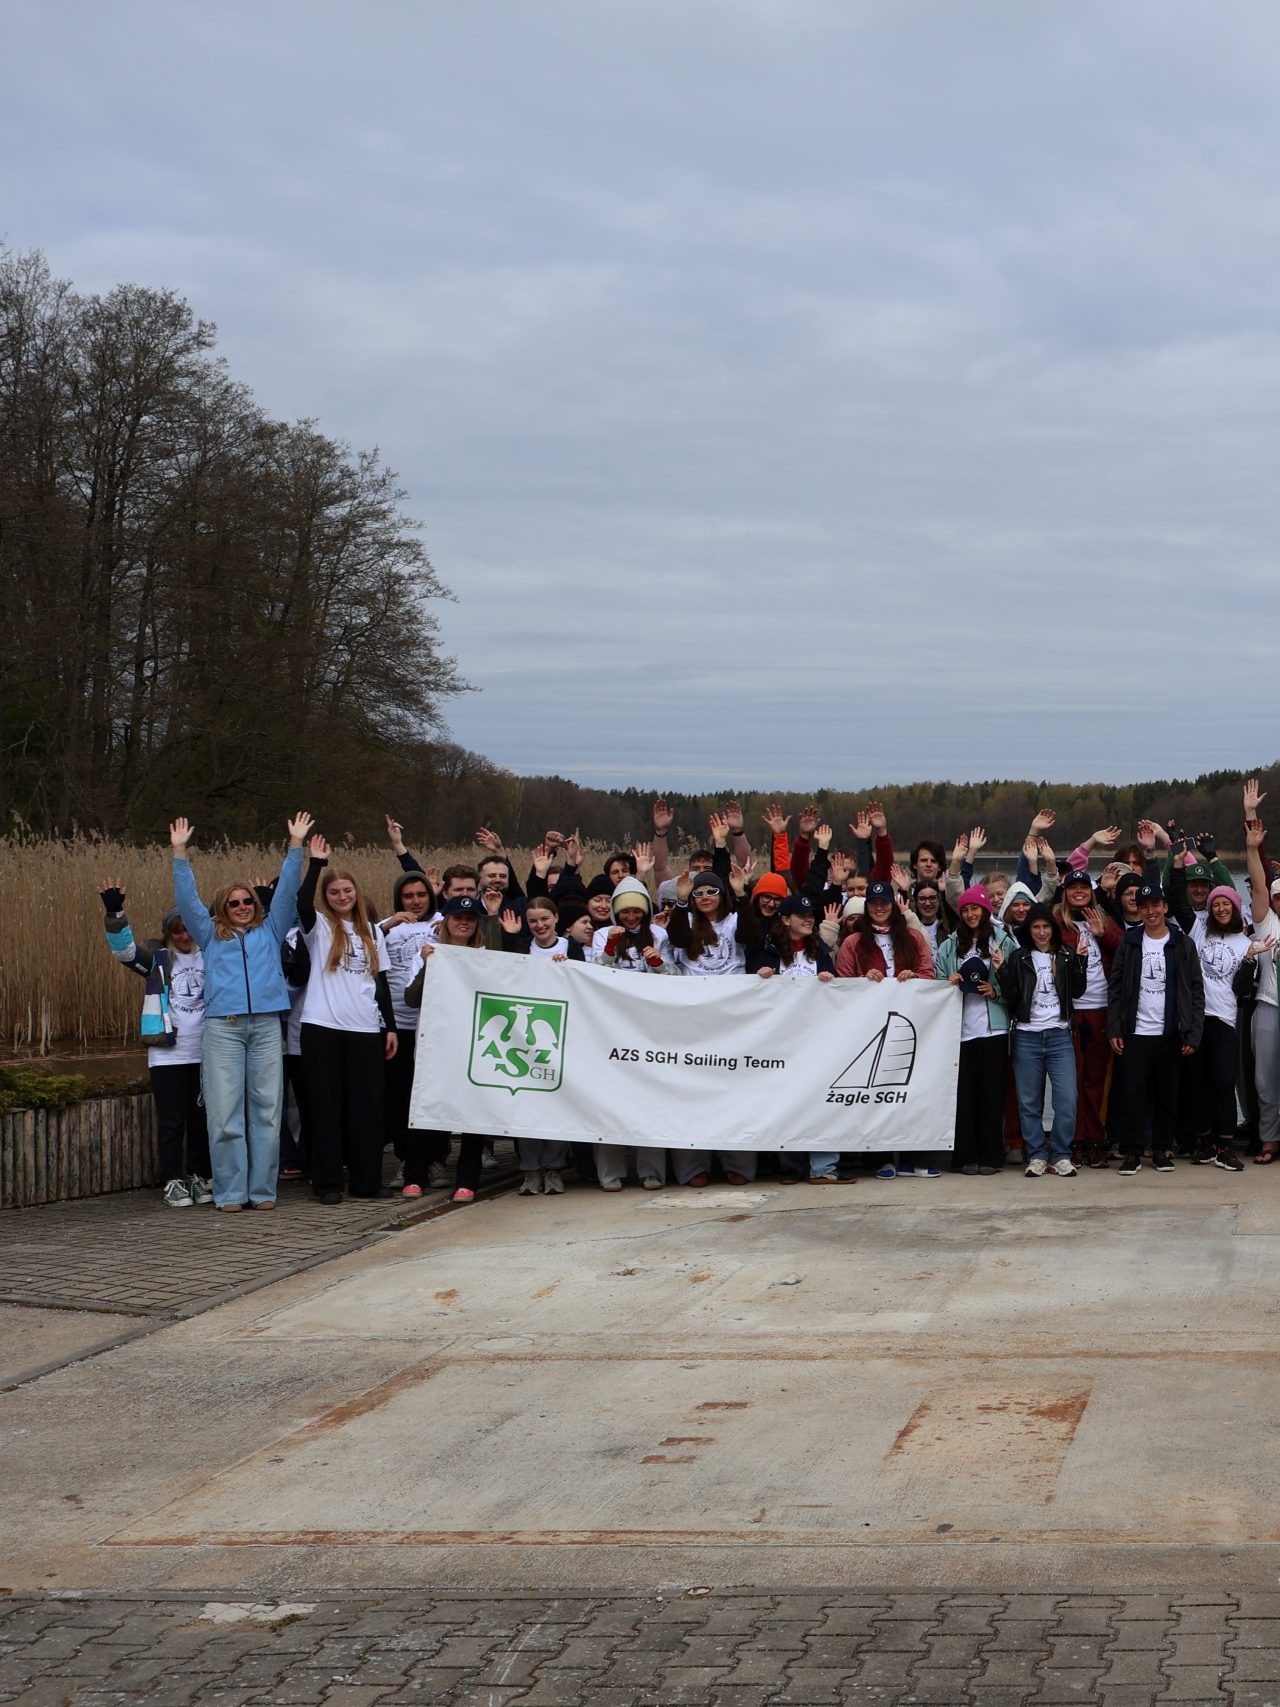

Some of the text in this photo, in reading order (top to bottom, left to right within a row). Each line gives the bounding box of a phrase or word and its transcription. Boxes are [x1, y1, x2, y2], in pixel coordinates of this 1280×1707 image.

[608, 1048, 785, 1071] AZS SGH Sailing Team
[826, 1090, 908, 1107] żagle SGH
